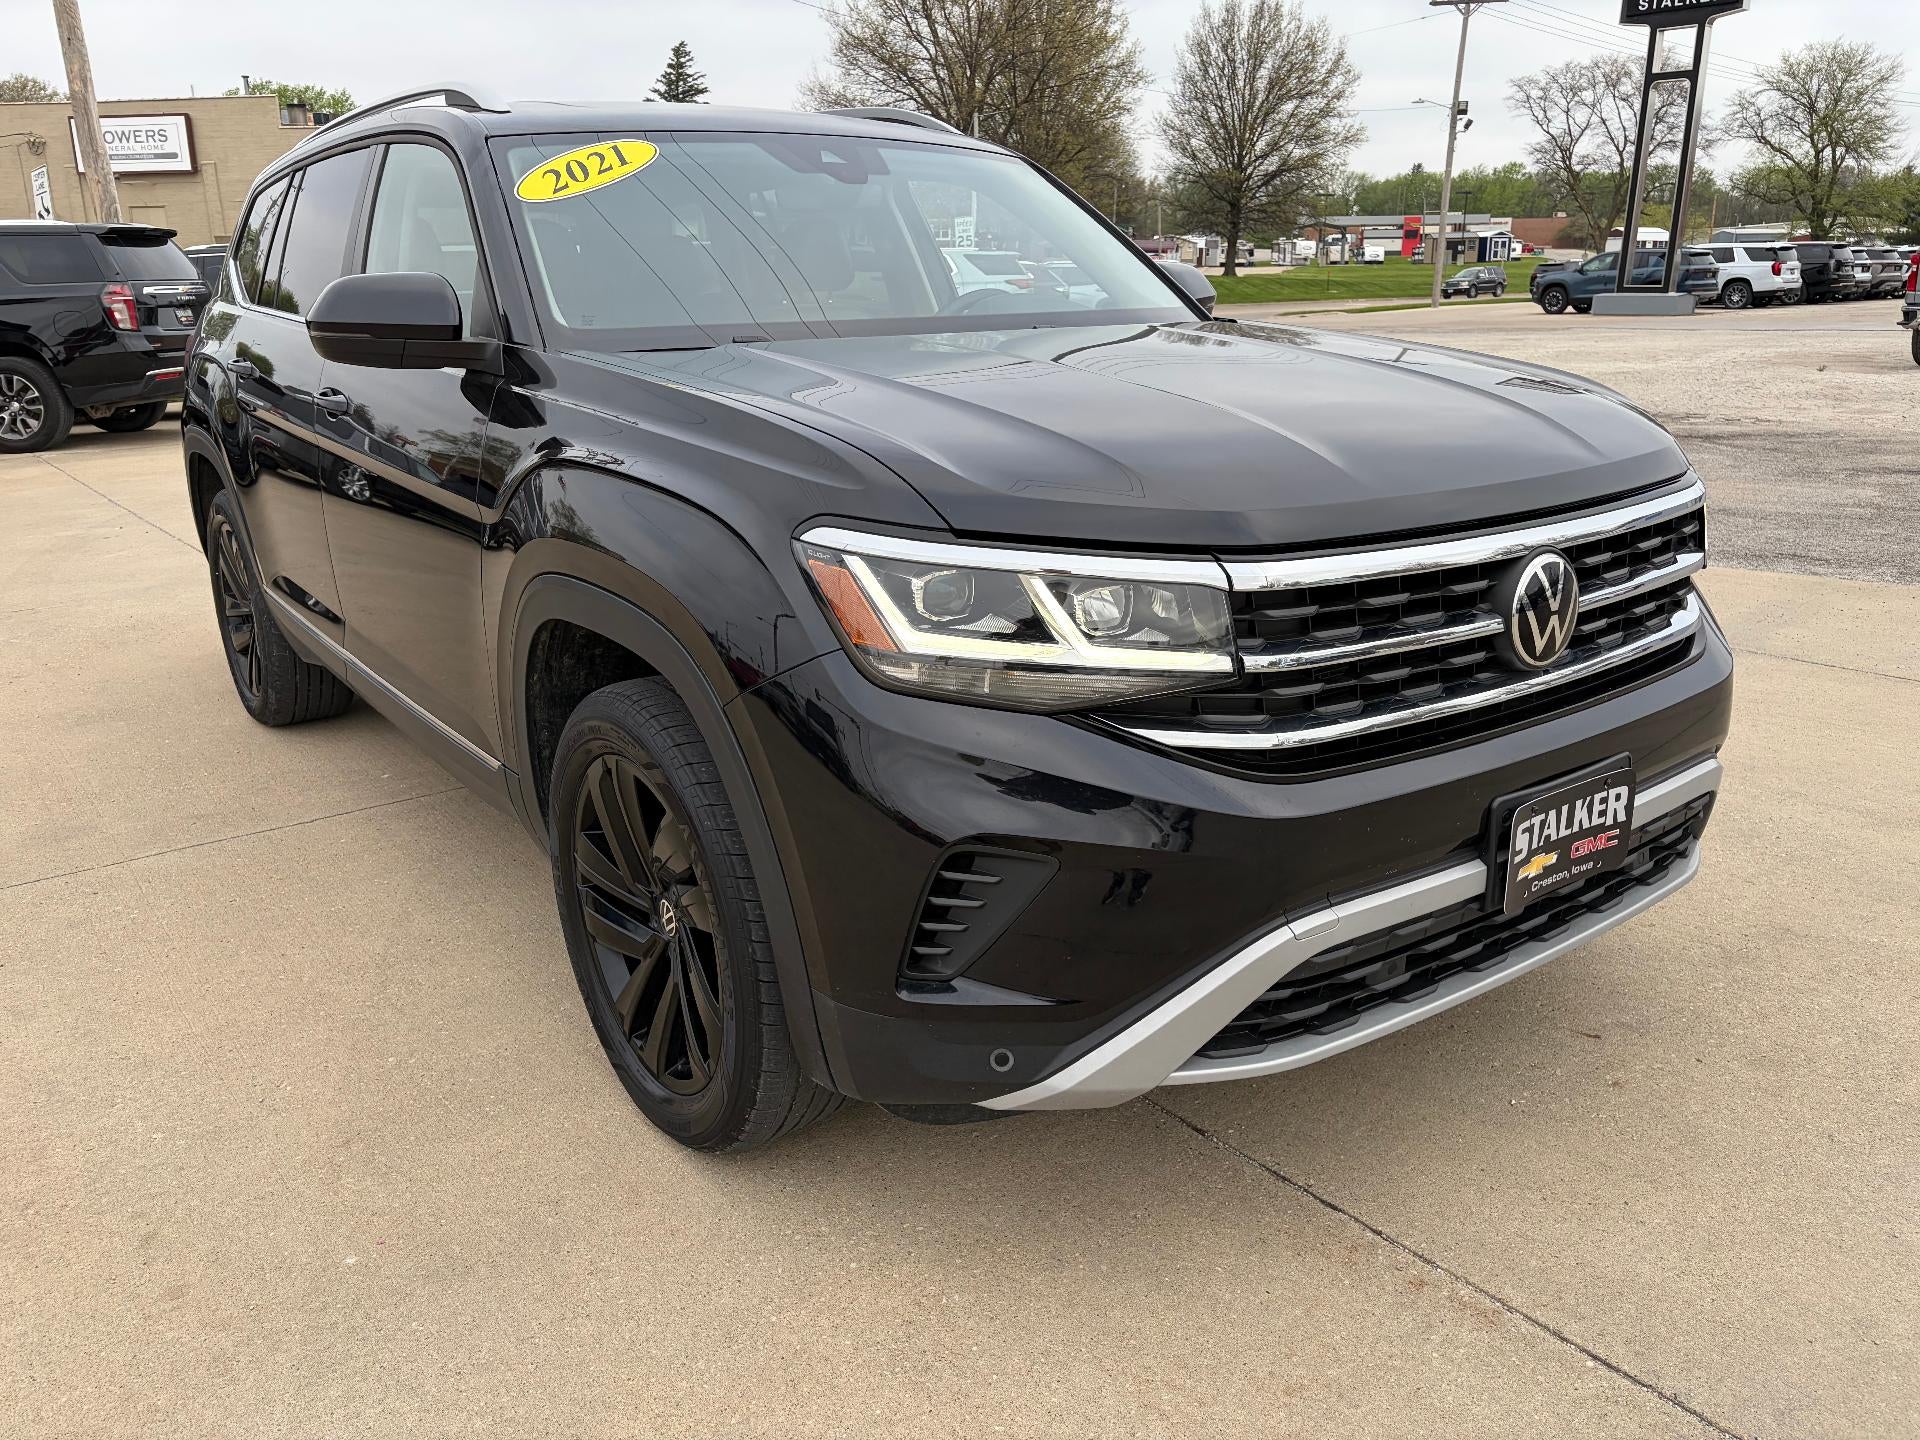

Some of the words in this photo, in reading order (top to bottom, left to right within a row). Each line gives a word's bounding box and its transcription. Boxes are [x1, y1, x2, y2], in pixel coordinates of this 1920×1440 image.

[1638, 0, 1716, 11] STAL
[102, 128, 169, 144] OWERS
[542, 144, 632, 195] 2021
[957, 235, 973, 247] 25
[1513, 785, 1629, 865] STALKER
[1570, 829, 1620, 859] GMC
[1530, 870, 1570, 892] Creston,
[1571, 861, 1594, 875] Iowa
